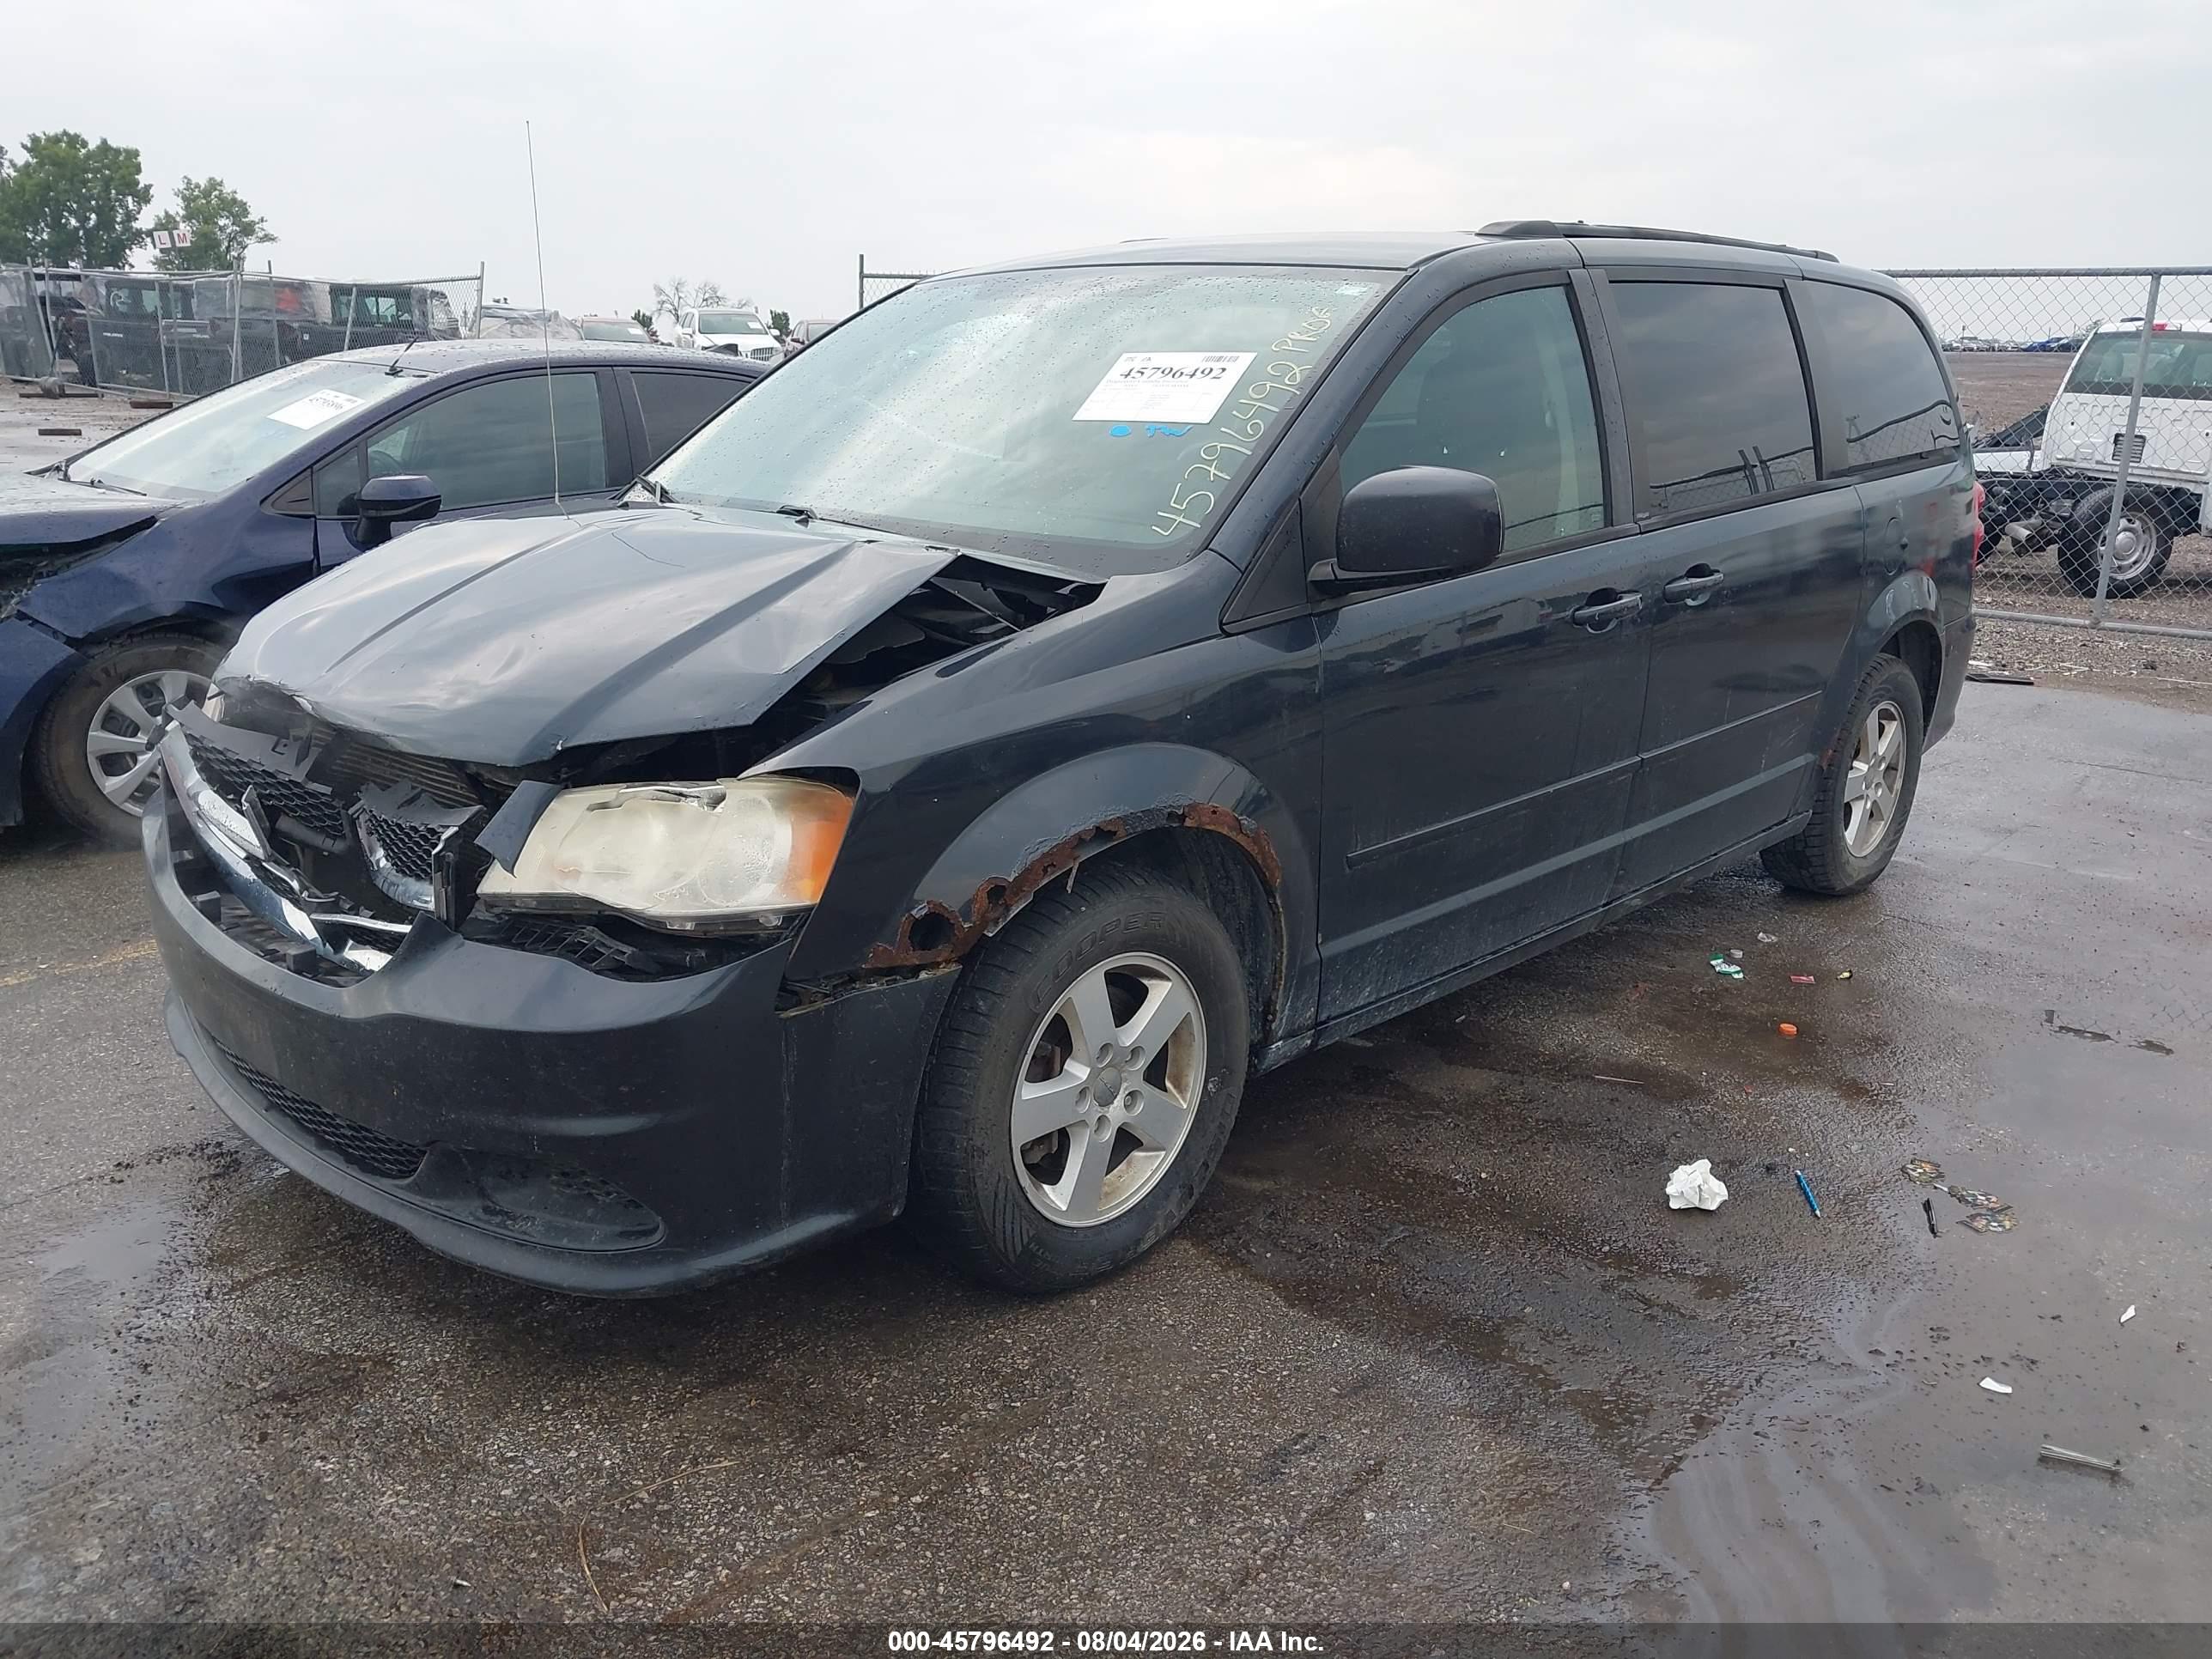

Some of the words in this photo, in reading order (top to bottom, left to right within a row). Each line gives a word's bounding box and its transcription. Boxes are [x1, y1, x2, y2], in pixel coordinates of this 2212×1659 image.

[158, 234, 167, 245] L
[177, 233, 188, 244] M
[1120, 367, 1227, 380] 45796492
[1152, 362, 1313, 537] 45796492
[1036, 911, 1167, 1004] COOPER
